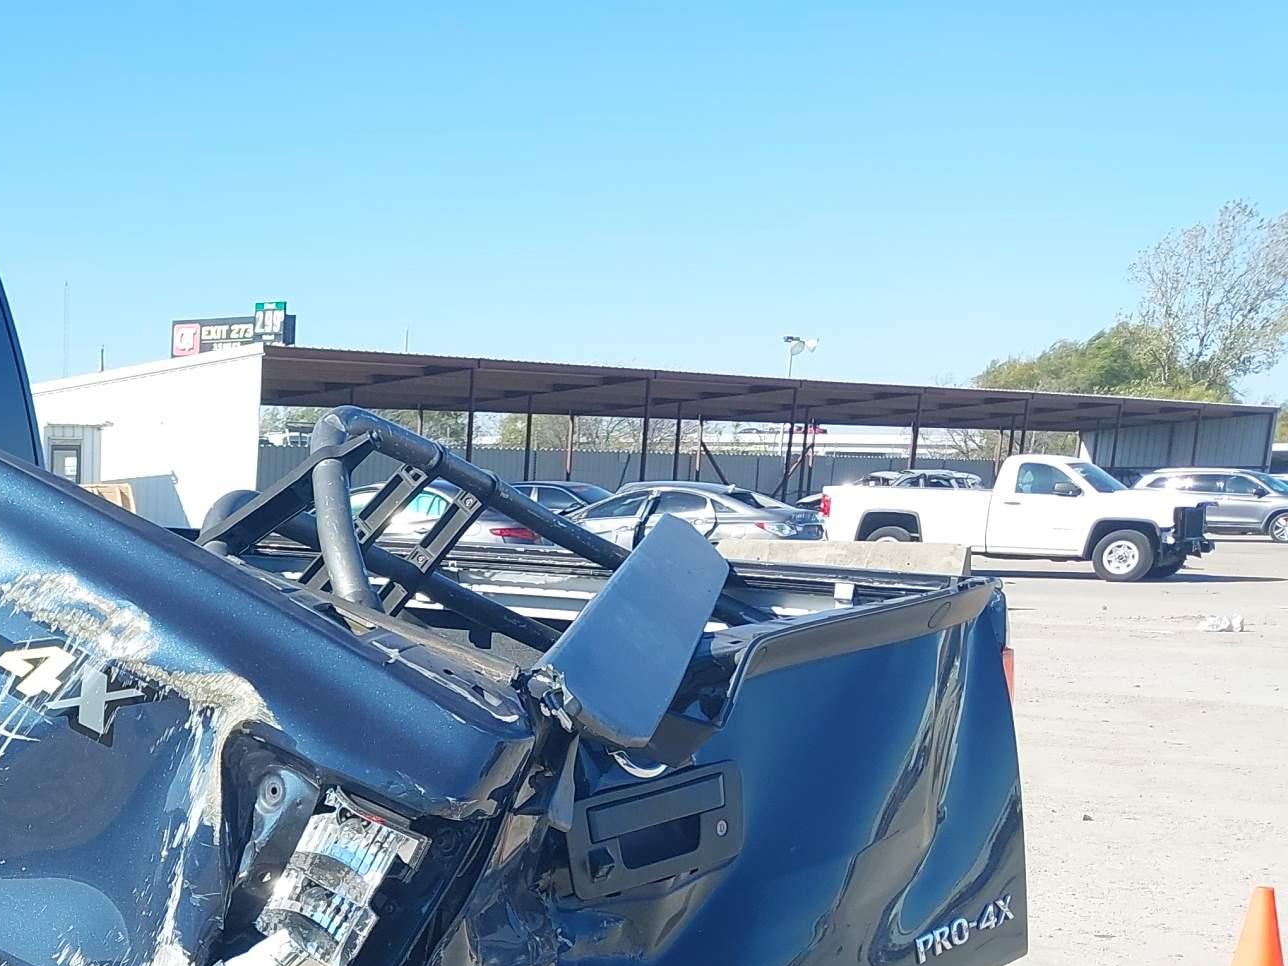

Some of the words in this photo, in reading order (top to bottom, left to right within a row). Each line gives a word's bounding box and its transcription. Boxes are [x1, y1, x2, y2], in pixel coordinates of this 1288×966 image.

[202, 325, 229, 340] EXIT
[230, 323, 253, 339] 273
[915, 895, 1015, 965] PRO-4X
